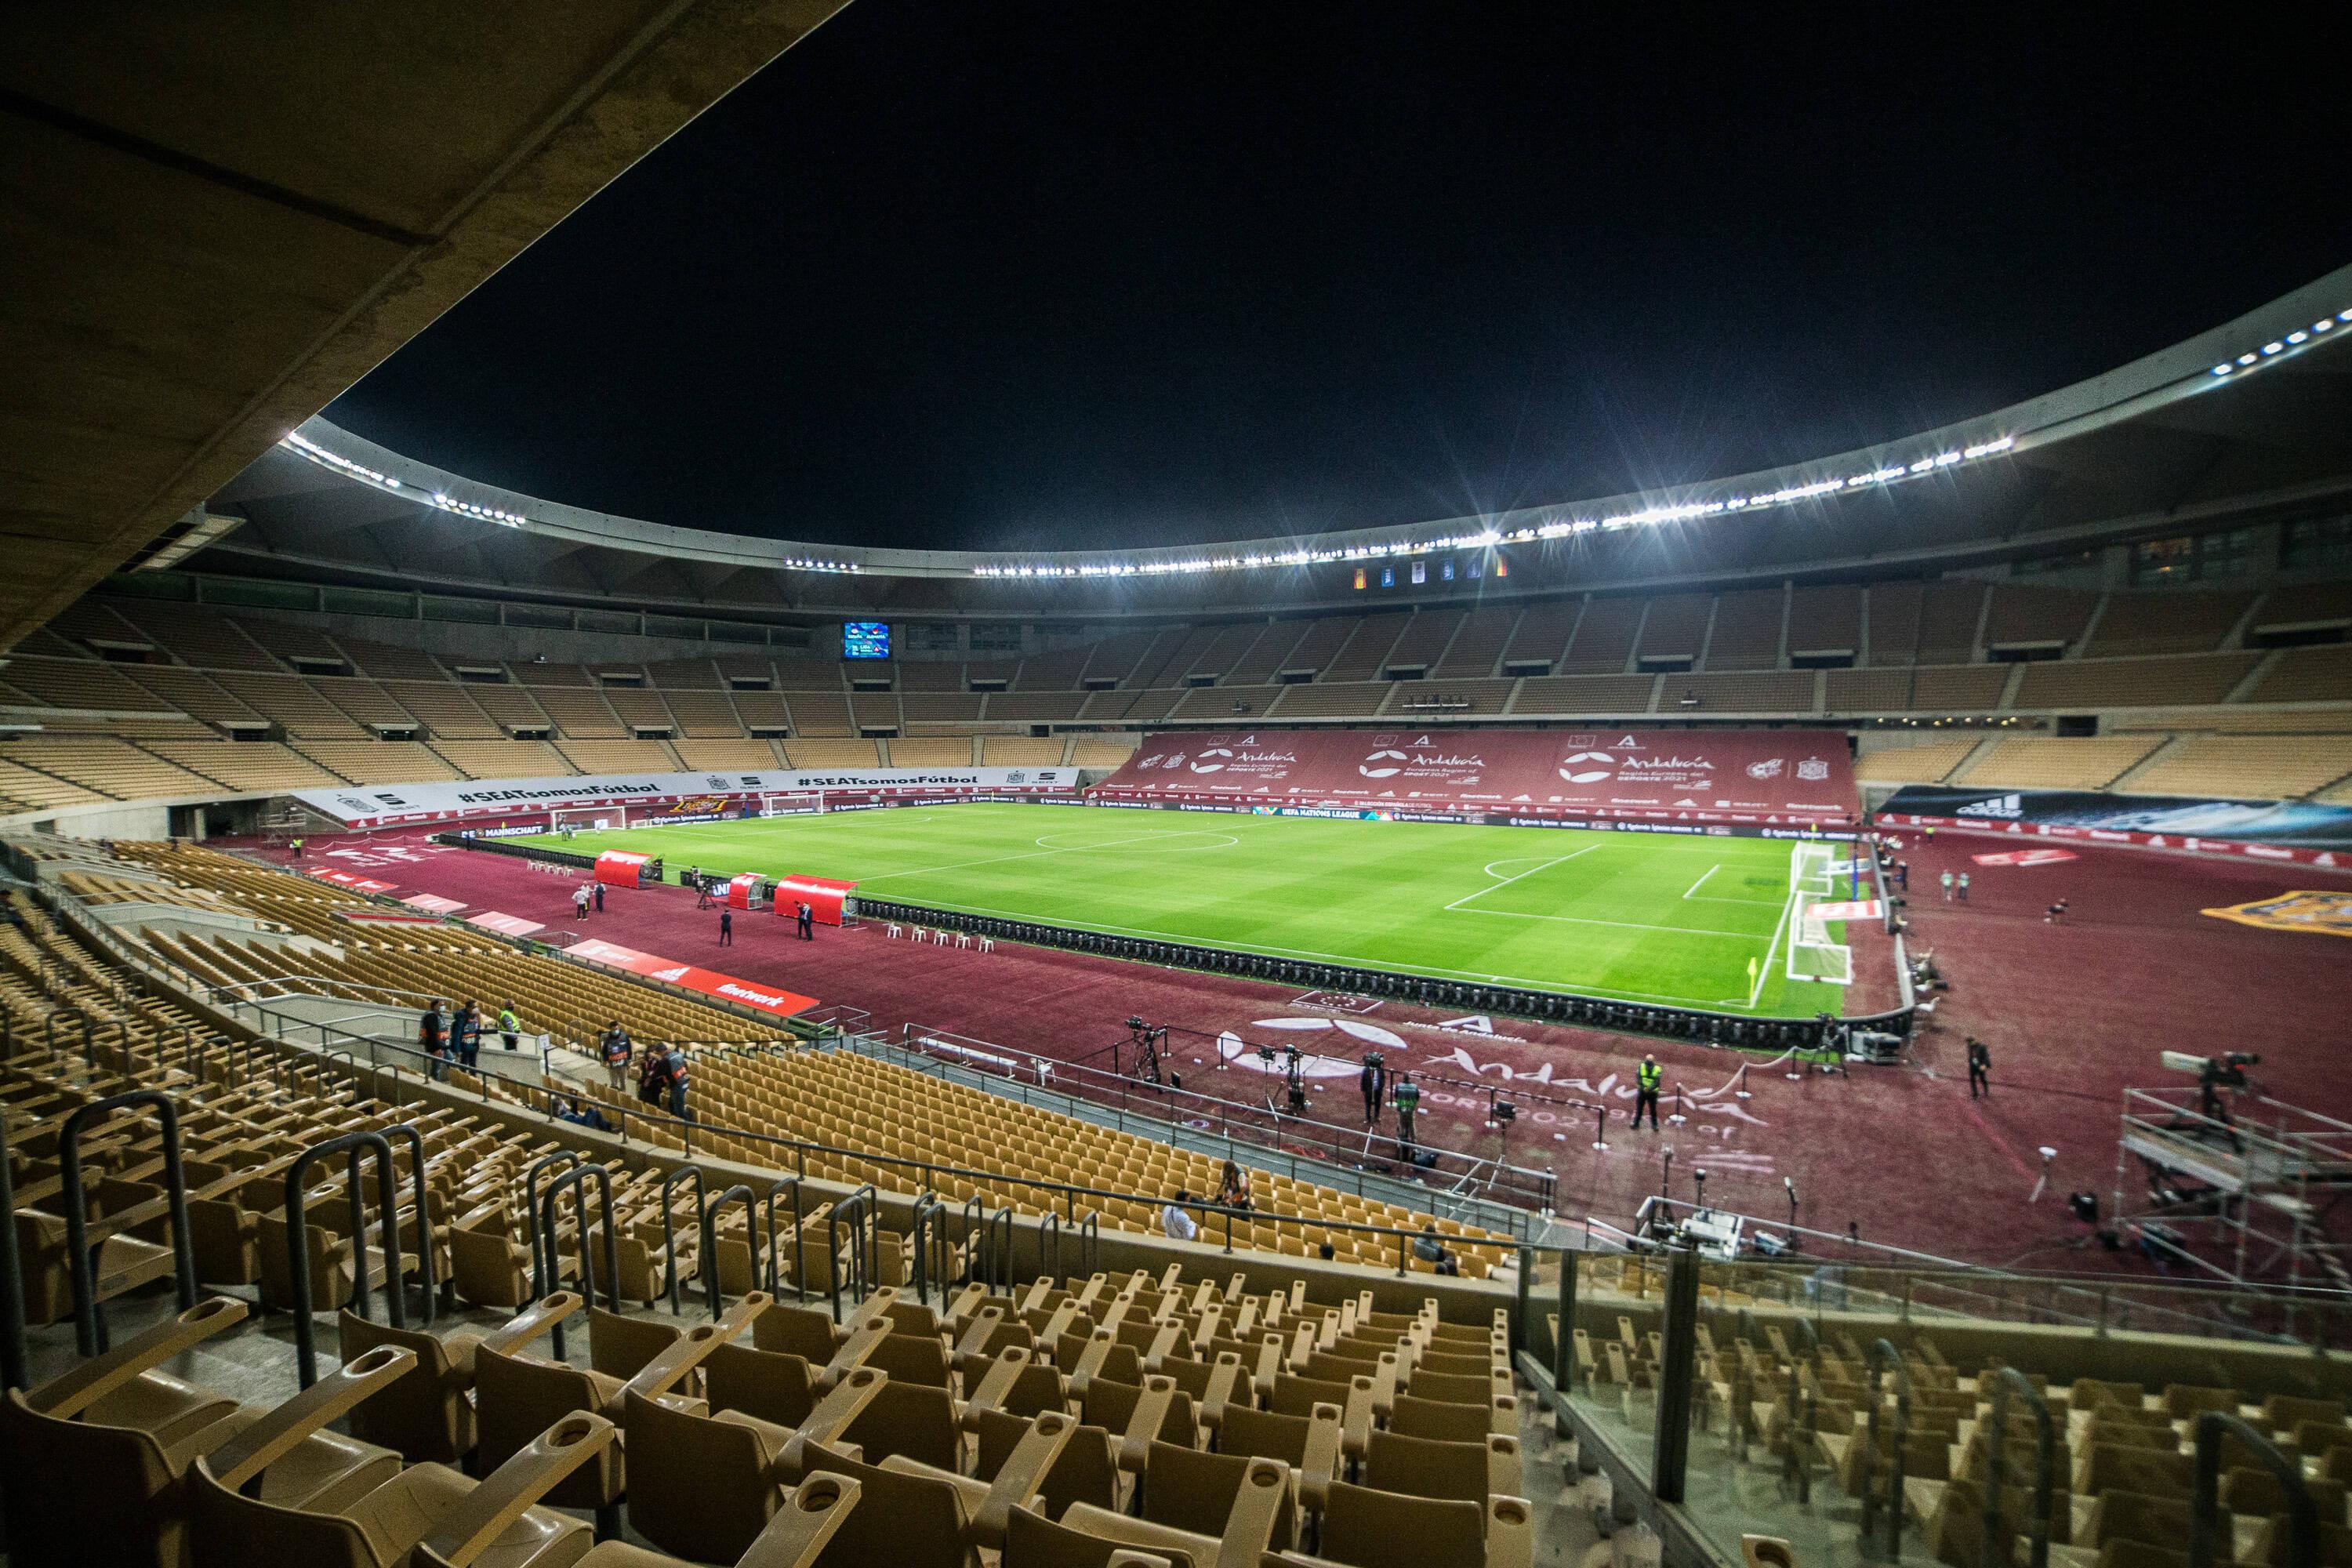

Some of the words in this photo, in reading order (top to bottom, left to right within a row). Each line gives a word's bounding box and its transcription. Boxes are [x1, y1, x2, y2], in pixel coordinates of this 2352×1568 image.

[1236, 751, 1297, 762] Andalucía
[1410, 753, 1486, 766] Andalucía
[1622, 756, 1716, 769] Andalucía
[797, 775, 978, 786] #SEATsomosFútbol
[458, 783, 662, 803] #SEATsomosFútbol
[485, 826, 543, 837] MANNSCHAFT
[716, 983, 784, 1007] finetwork
[1421, 1047, 1769, 1127] Andaluía
